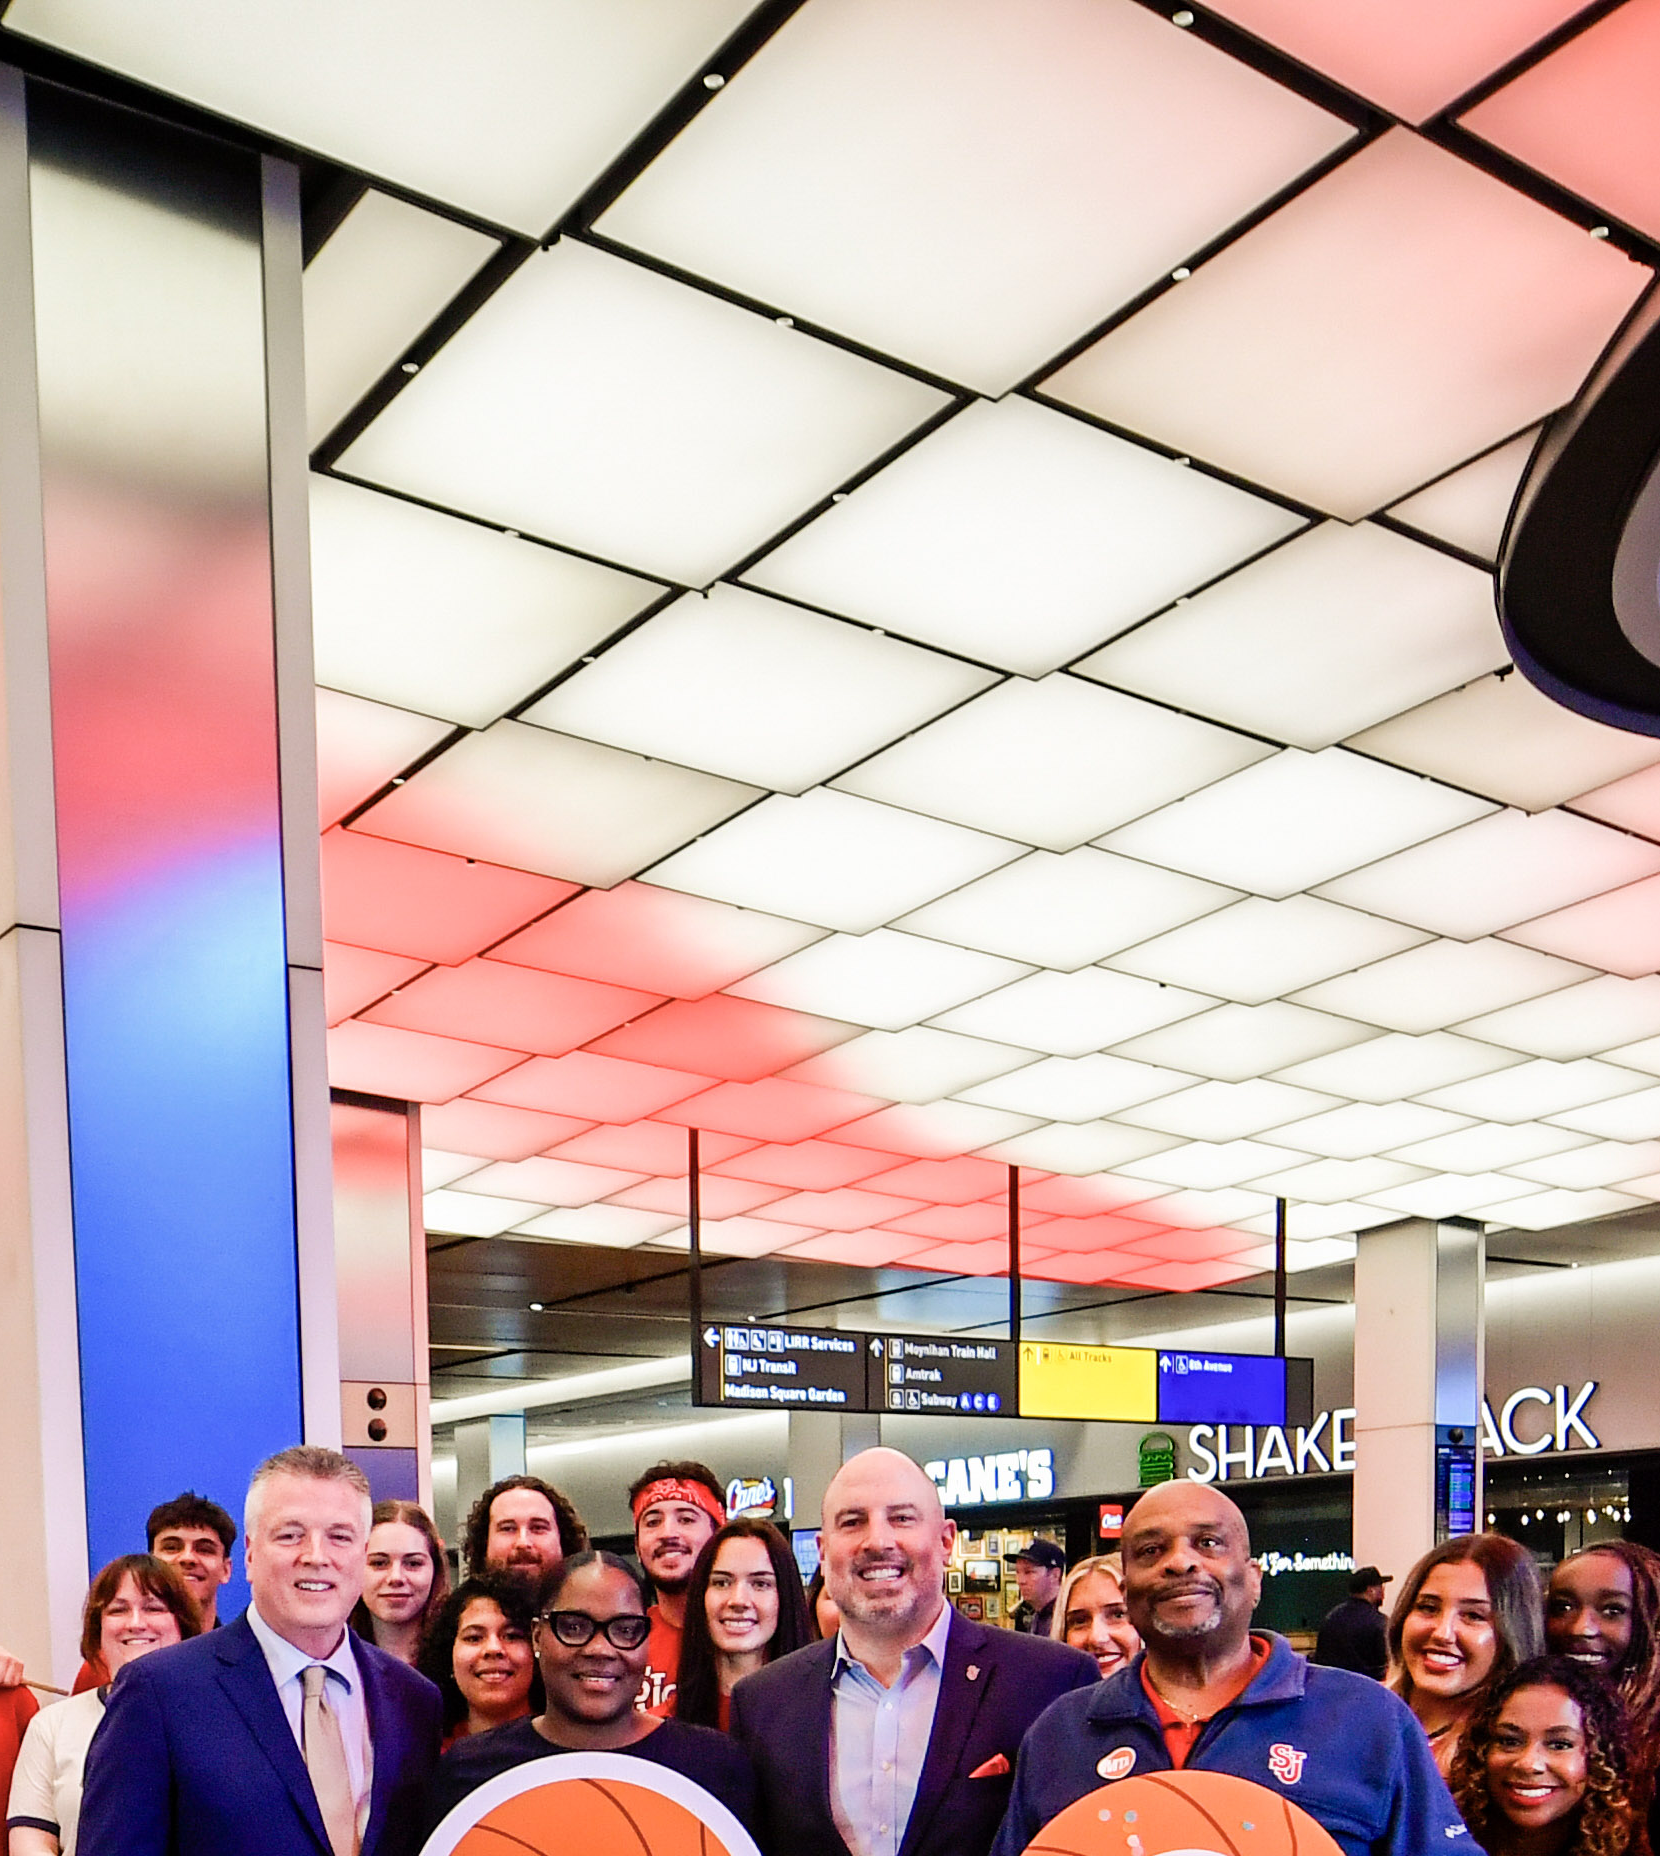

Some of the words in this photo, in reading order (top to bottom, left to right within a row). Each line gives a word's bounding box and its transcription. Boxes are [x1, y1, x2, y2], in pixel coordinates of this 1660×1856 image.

[784, 1335, 810, 1350] LIRR
[811, 1336, 855, 1353] Services
[904, 1343, 951, 1359] Moynihan
[951, 1344, 976, 1359] Train
[976, 1346, 996, 1360] Hall
[742, 1357, 758, 1373] NJ
[759, 1358, 798, 1376] Transit
[1068, 1352, 1081, 1361] All
[1082, 1352, 1113, 1364] Tracks
[905, 1367, 943, 1382] Amtrak
[1203, 1361, 1234, 1374] Avenue
[724, 1383, 769, 1399] Madison
[769, 1384, 807, 1403] Square
[807, 1386, 847, 1403] Garden
[921, 1392, 958, 1410] Subway
[1187, 1407, 1357, 1484] SHAKE
[924, 1448, 1055, 1504] CANE'S
[1293, 1551, 1356, 1572] Somethin
